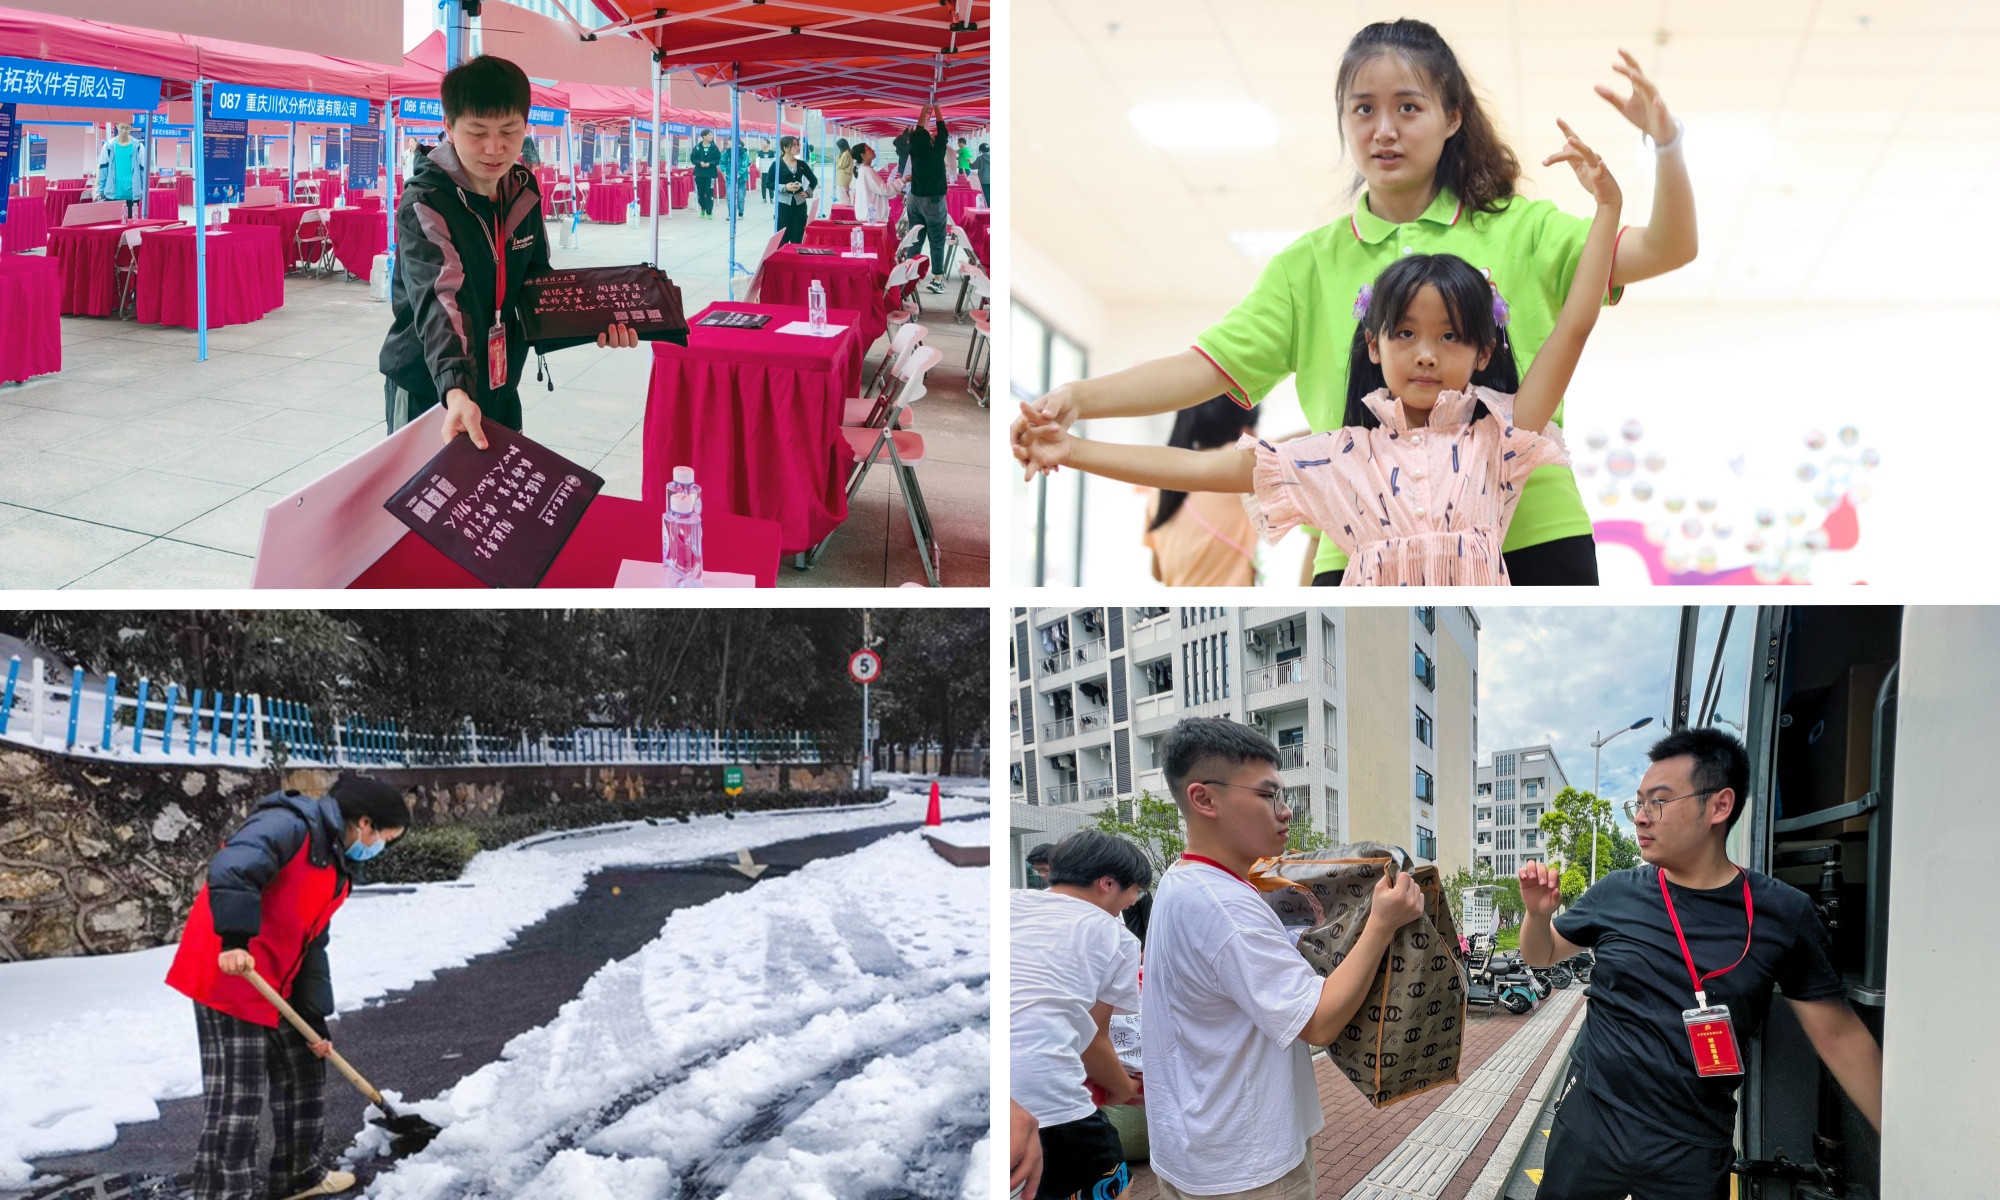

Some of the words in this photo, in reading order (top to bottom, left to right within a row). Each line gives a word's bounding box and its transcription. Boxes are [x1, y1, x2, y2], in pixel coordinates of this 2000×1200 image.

[219, 92, 241, 110] 087
[245, 93, 357, 118] 重庆川仪分析仪器有限公司
[404, 99, 417, 113] 086
[860, 658, 870, 674] 5
